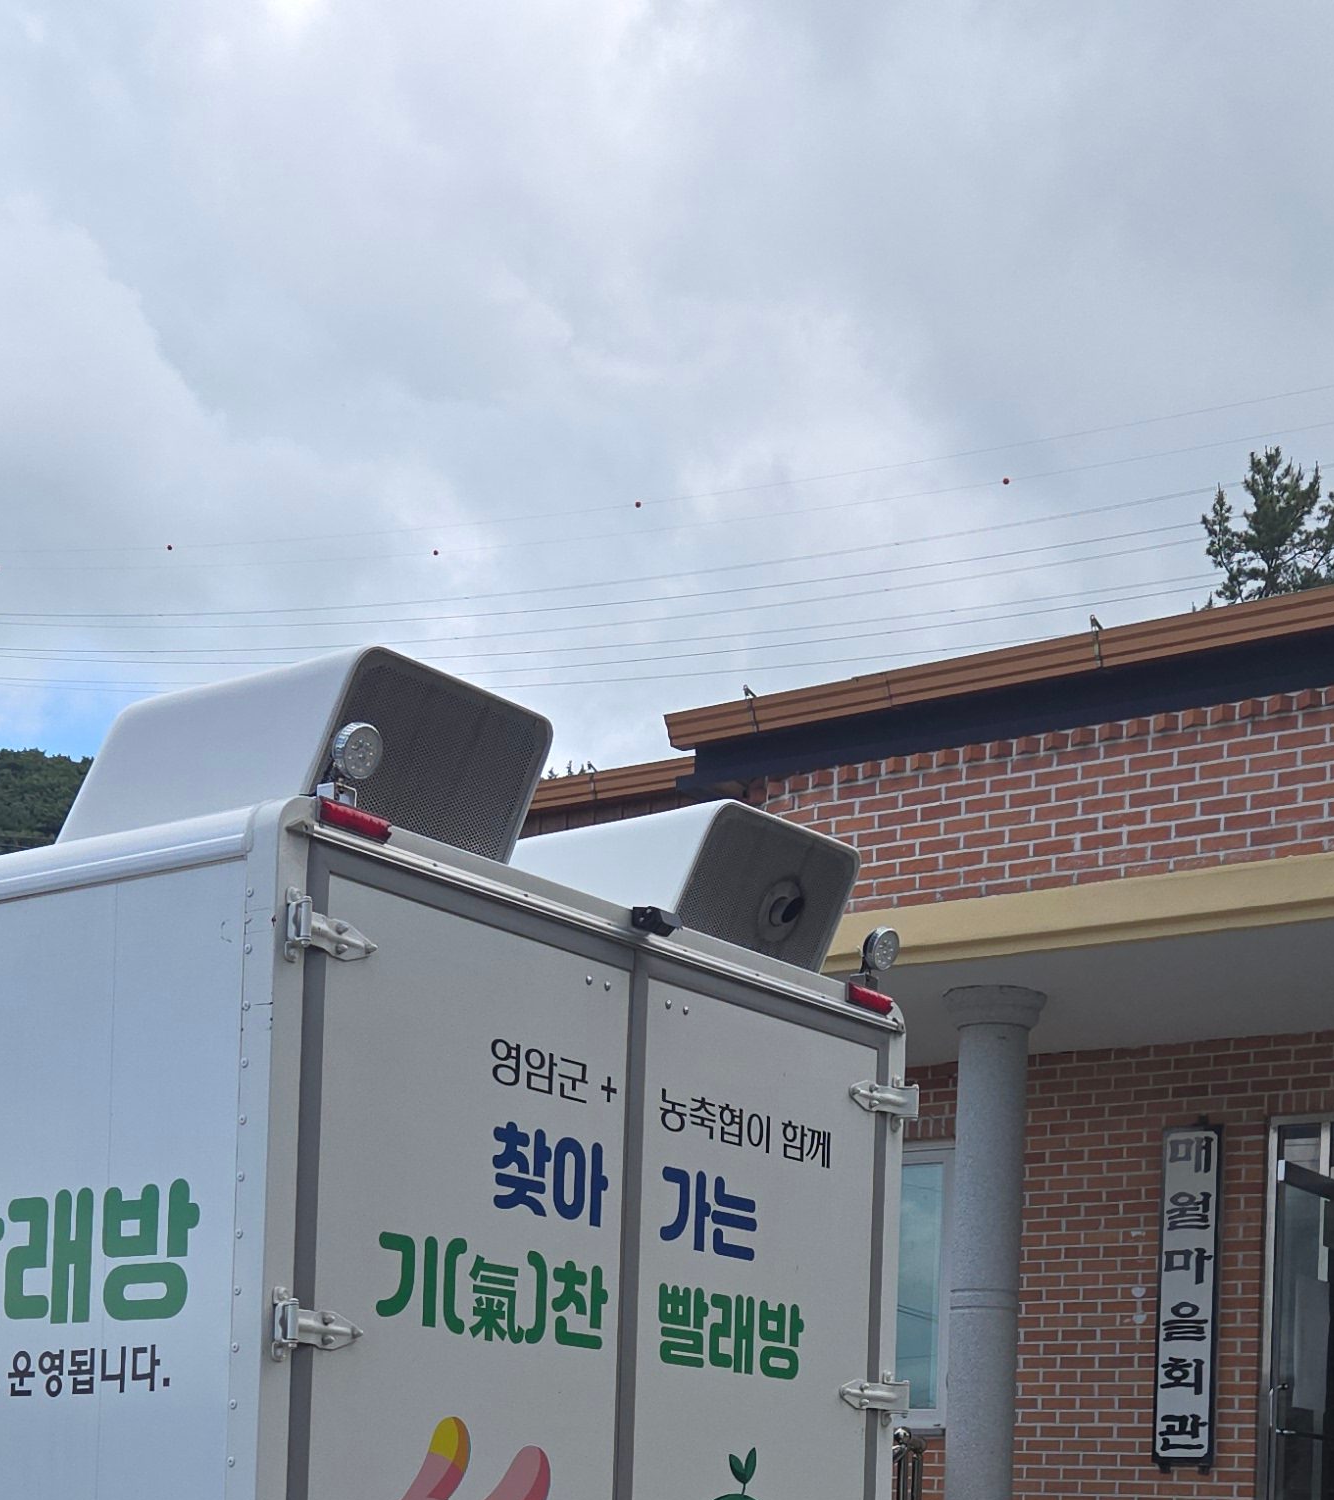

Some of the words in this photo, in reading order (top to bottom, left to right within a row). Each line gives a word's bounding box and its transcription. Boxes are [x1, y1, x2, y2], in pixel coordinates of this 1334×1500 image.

[490, 1038, 588, 1104] 영암군
[659, 1087, 771, 1154] 농축협이
[782, 1119, 832, 1169] 함께
[492, 1121, 608, 1228] 찾아
[660, 1165, 757, 1261] 가는
[375, 1231, 609, 1350] 기(氣)찬
[658, 1282, 805, 1380] 빨래방
[1158, 1136, 1214, 1451] 매월마을회관
[8, 1343, 171, 1397] 운영됩니다.
